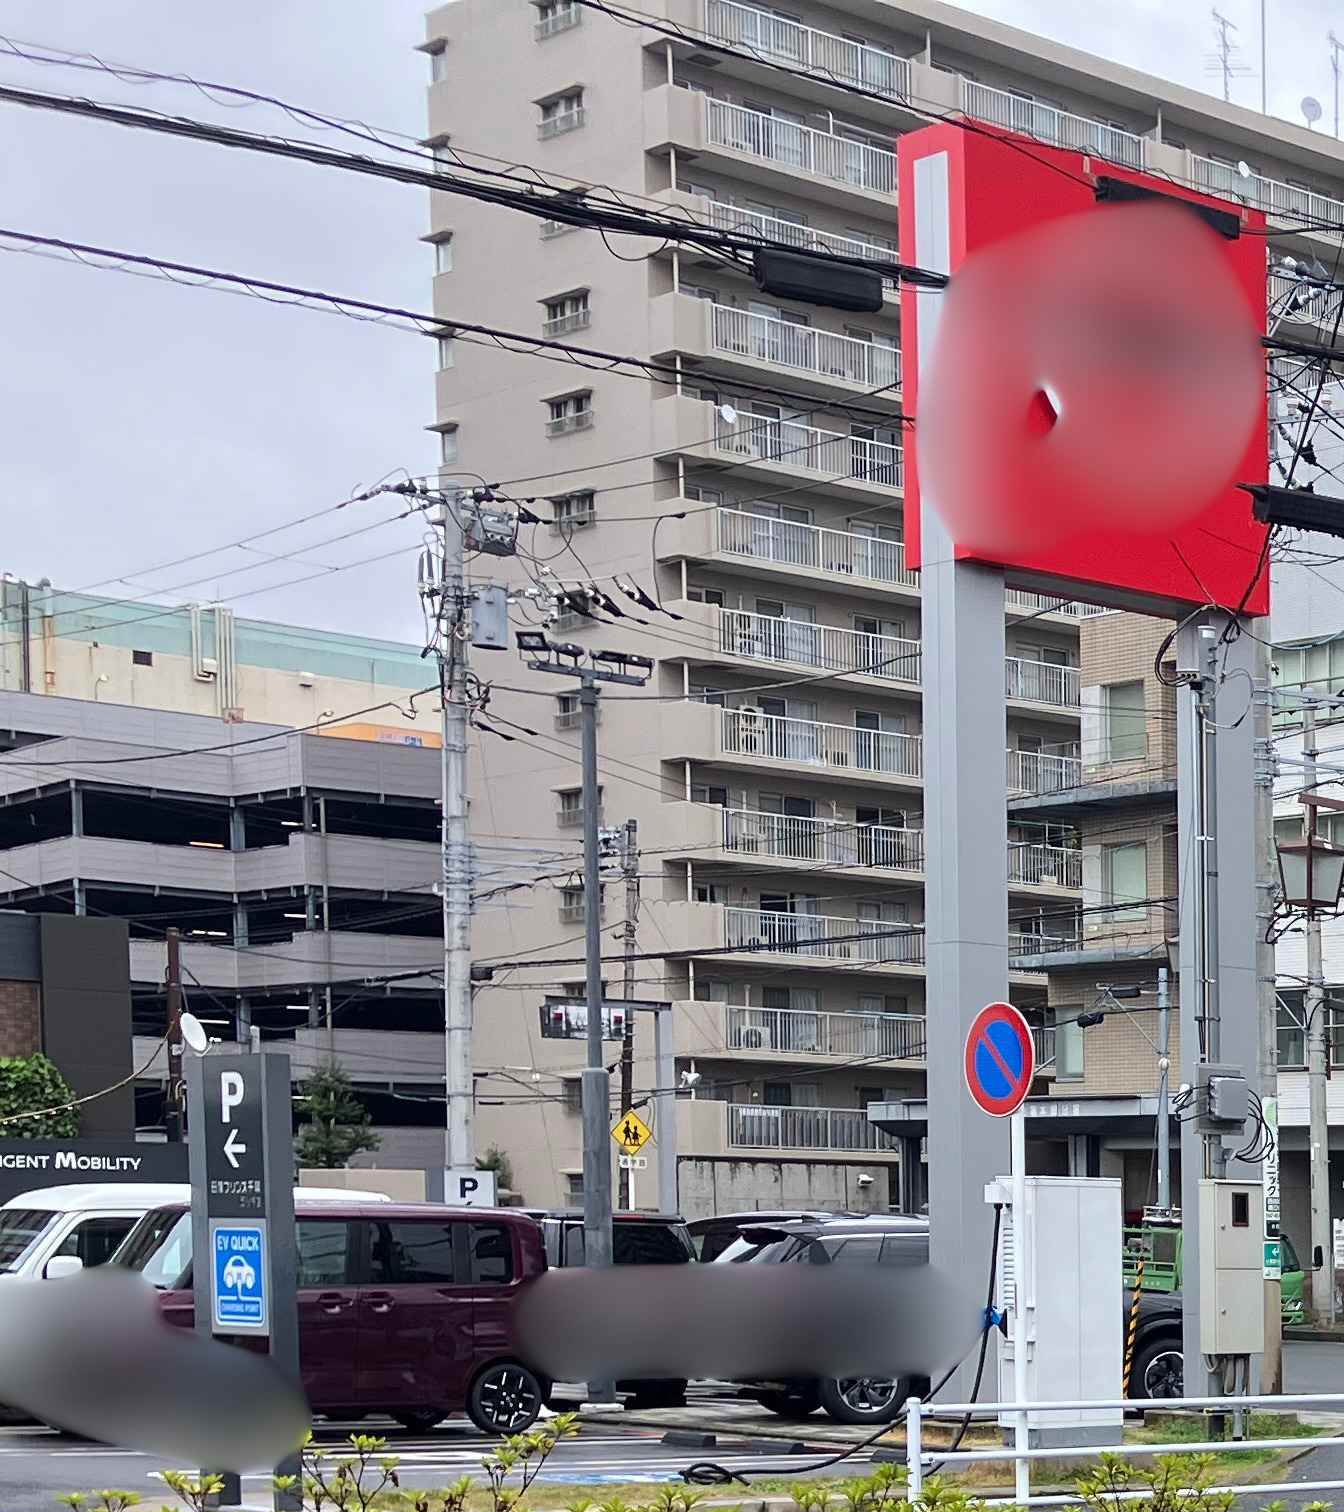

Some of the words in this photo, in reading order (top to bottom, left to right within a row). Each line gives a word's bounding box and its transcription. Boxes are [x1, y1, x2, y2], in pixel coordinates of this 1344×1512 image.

[220, 1071, 245, 1124] P
[54, 1151, 142, 1171] MOBILITY
[459, 1176, 479, 1199] P
[217, 1235, 230, 1251] EV
[230, 1236, 260, 1252] QUICK
